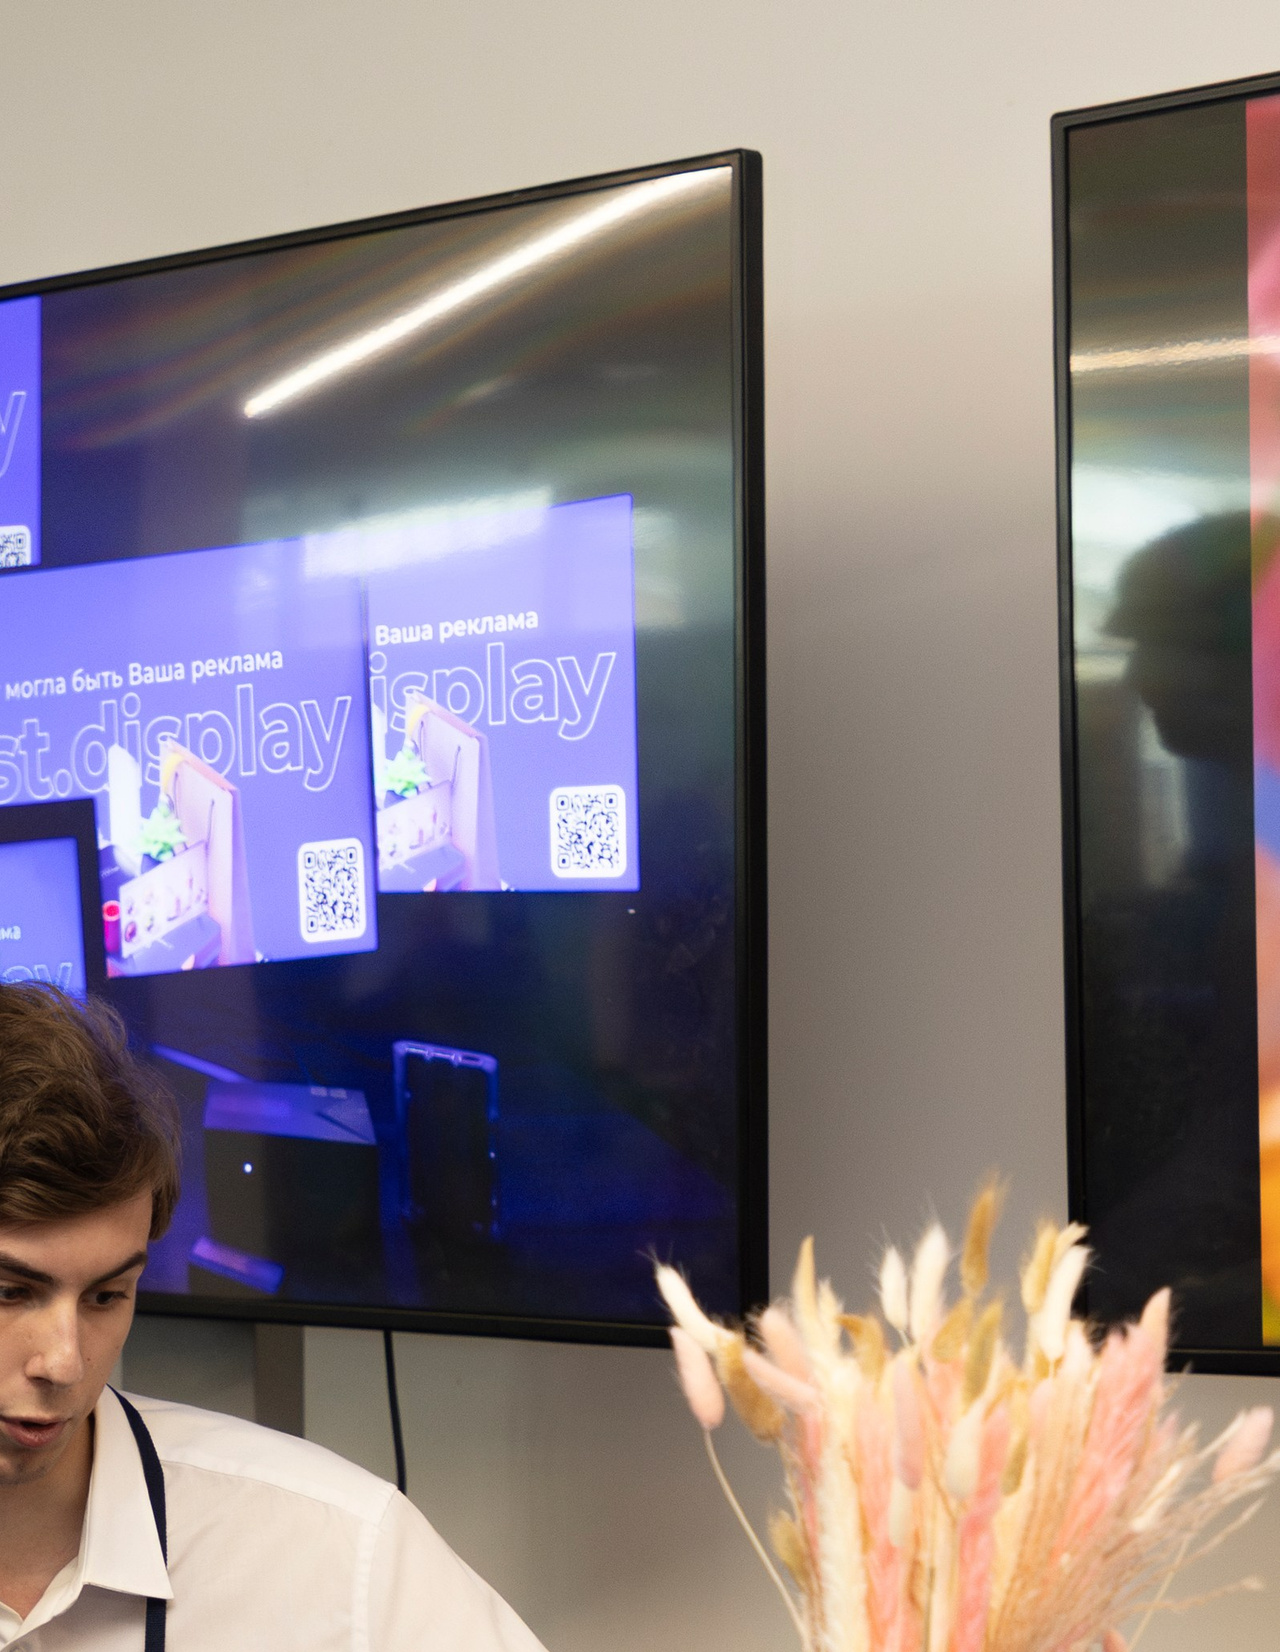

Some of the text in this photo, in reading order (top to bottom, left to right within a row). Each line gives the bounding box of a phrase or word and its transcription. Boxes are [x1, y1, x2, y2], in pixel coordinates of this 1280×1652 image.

[374, 611, 539, 646] Ваша реклама
[5, 676, 67, 698] могла
[71, 668, 123, 692] быть
[128, 662, 185, 685] Ваша
[191, 650, 284, 683] реклама
